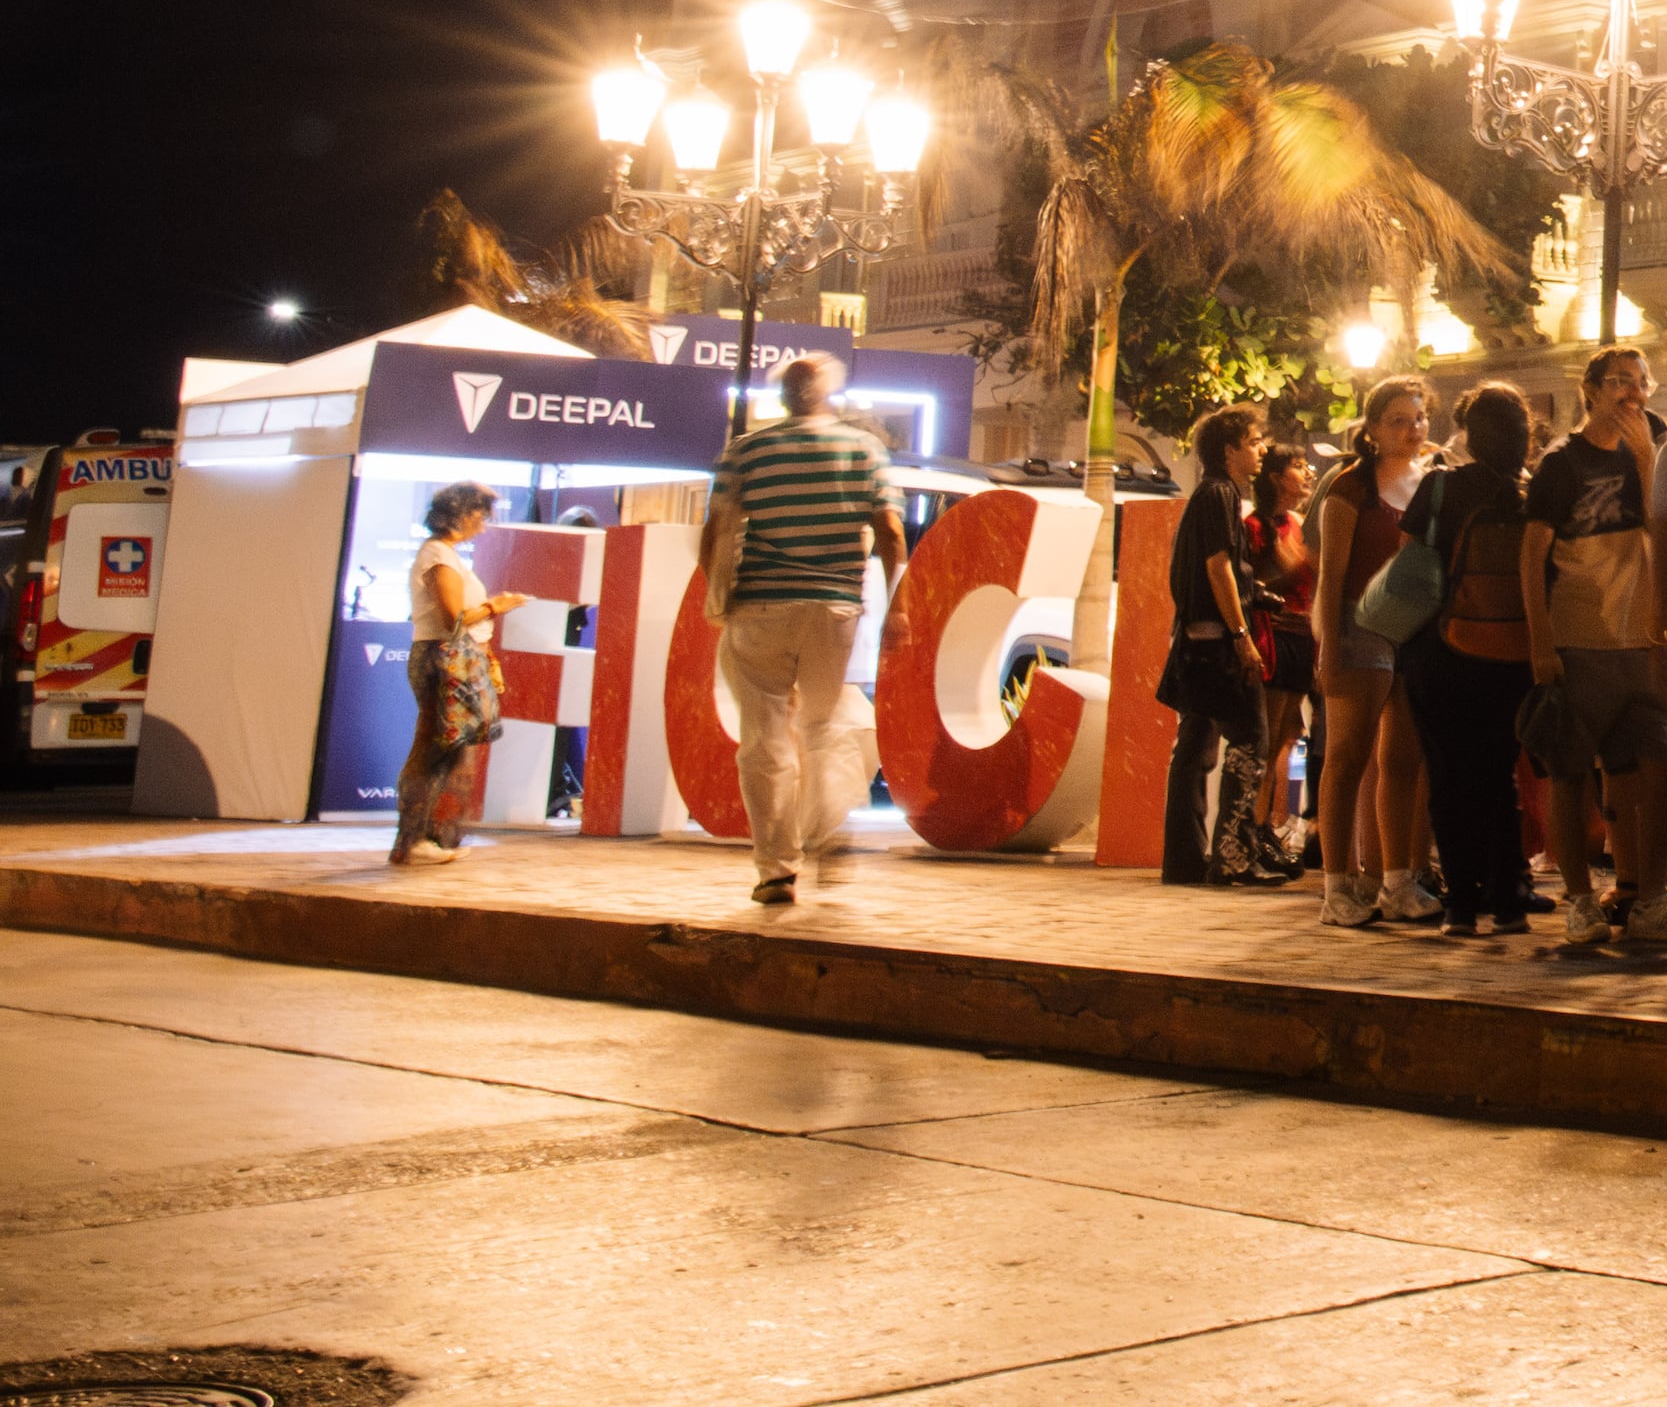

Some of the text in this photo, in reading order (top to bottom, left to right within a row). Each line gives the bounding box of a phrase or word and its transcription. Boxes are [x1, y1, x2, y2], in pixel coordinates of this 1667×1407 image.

[694, 340, 809, 369] DEPA
[508, 391, 656, 430] DEEPAL
[71, 458, 173, 483] AMBU
